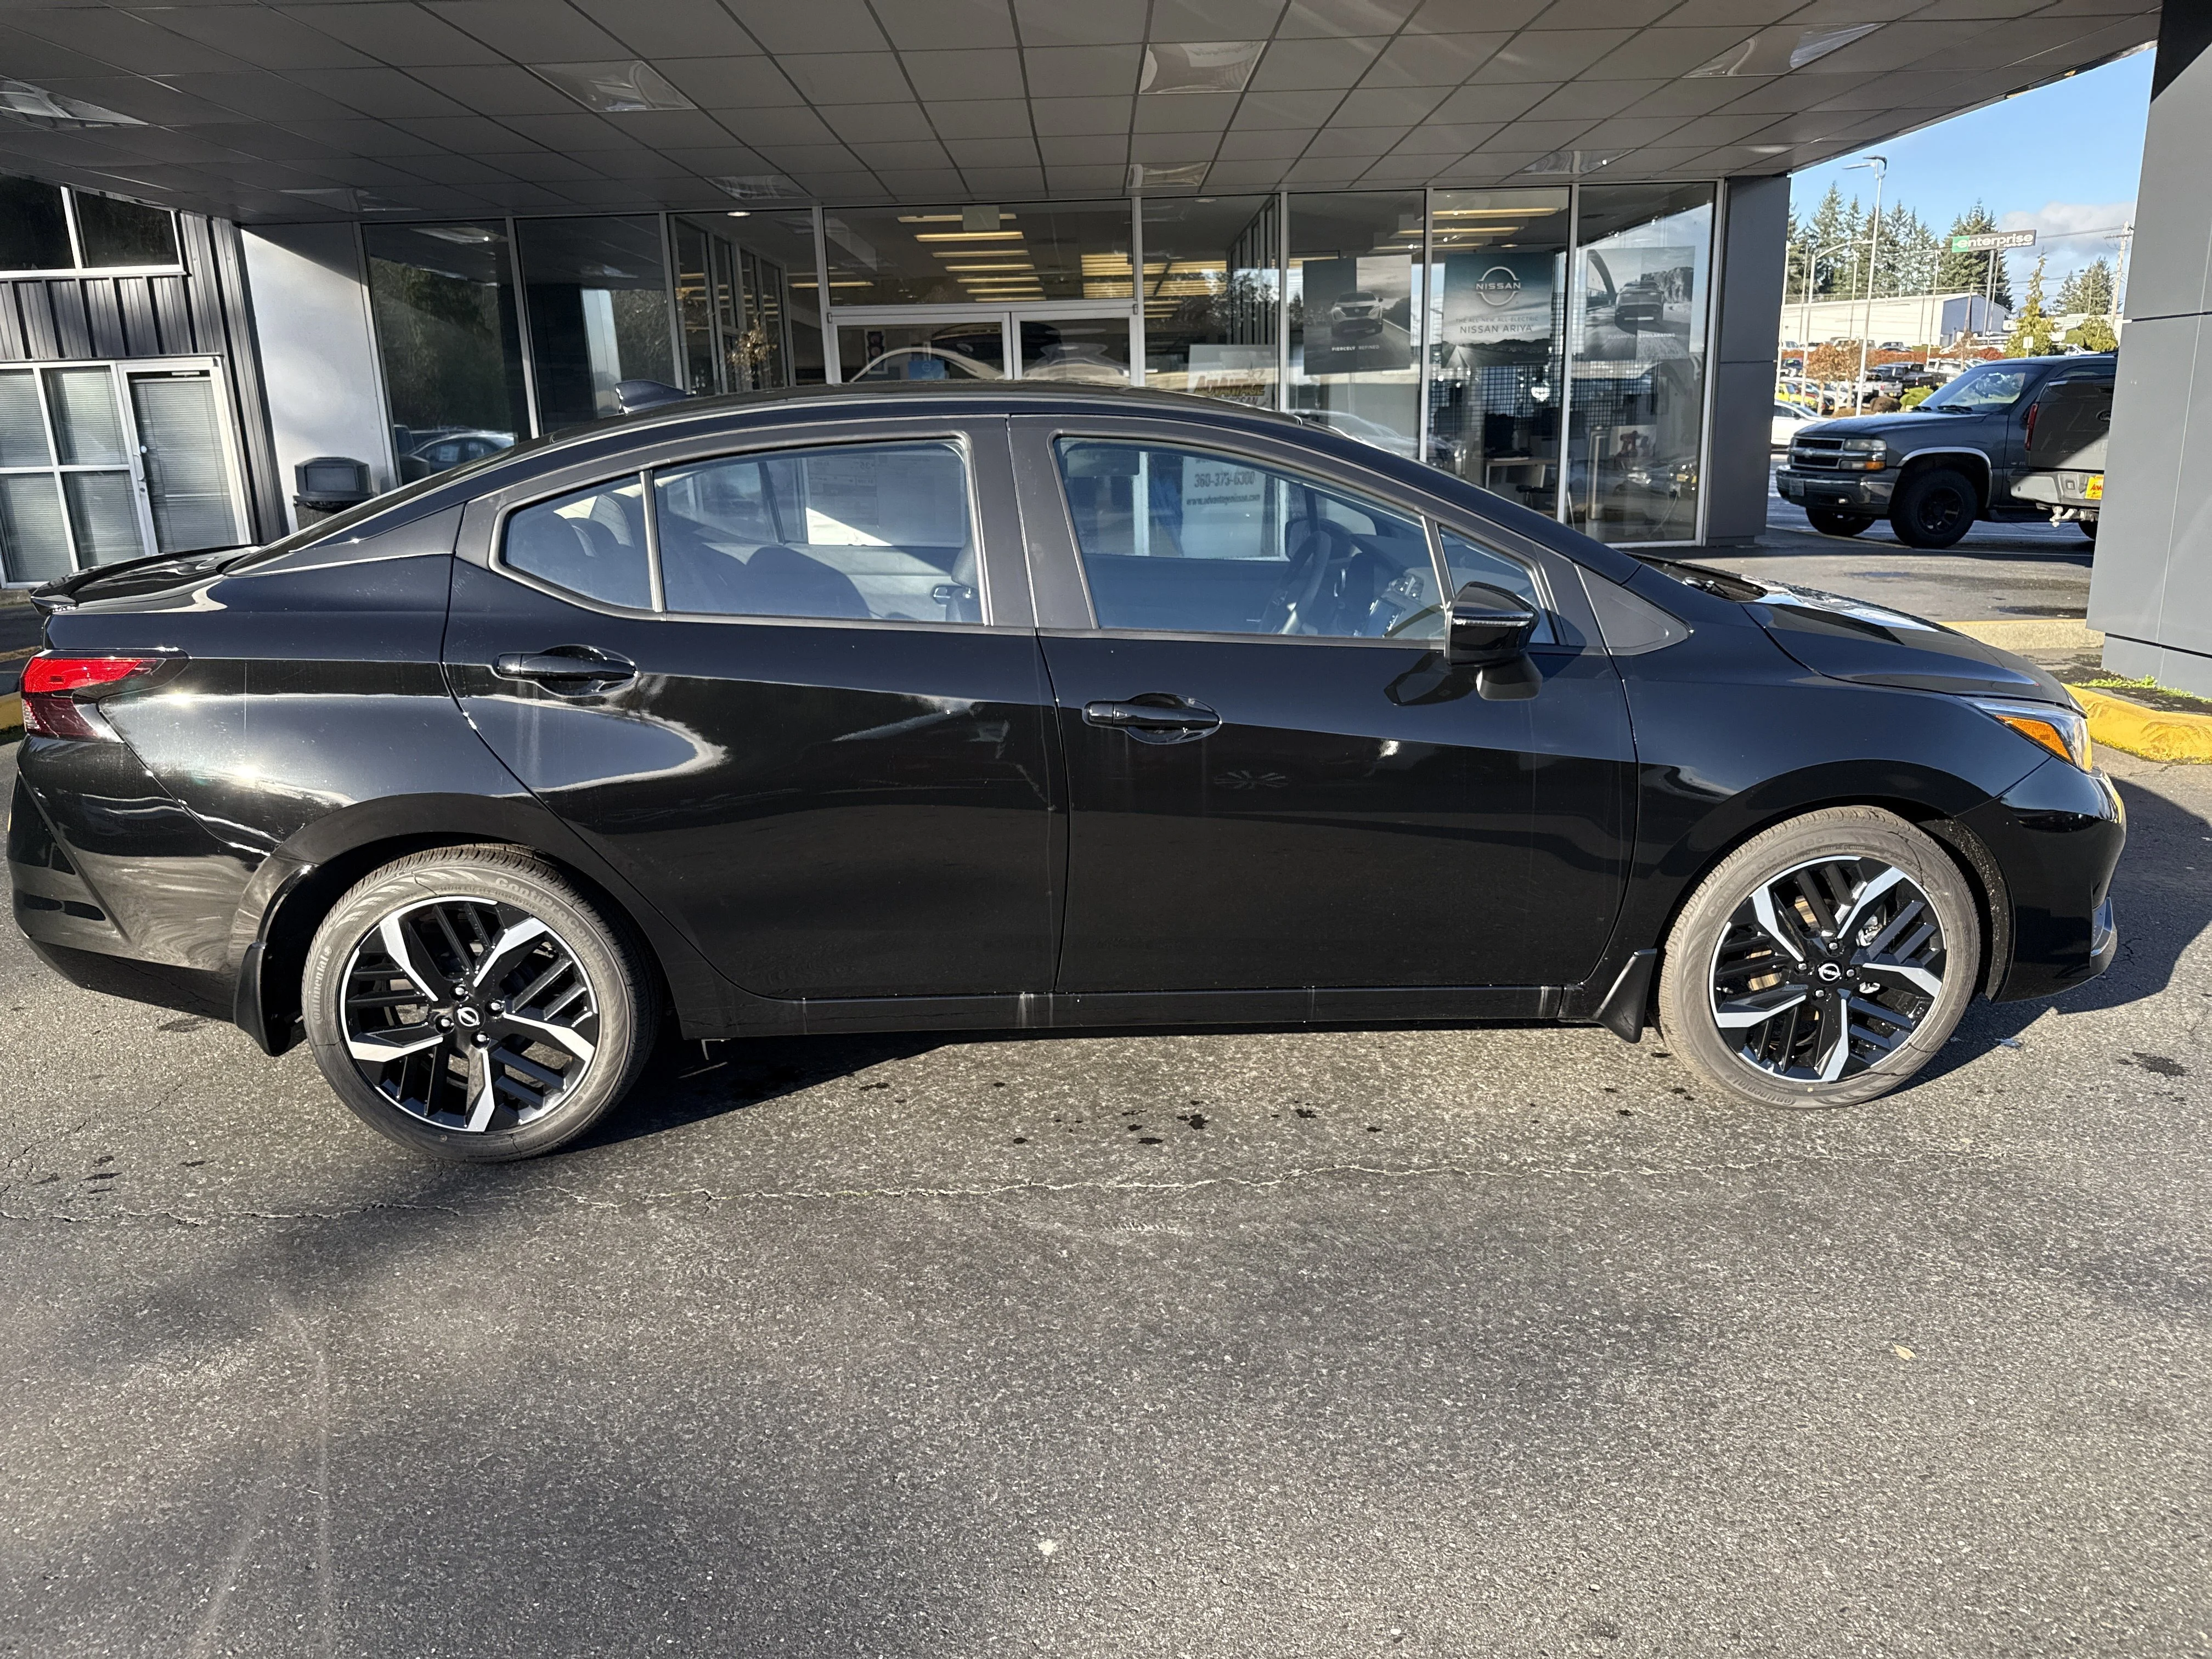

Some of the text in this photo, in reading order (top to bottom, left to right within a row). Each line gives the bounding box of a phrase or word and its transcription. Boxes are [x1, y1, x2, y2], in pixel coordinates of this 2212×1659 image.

[1957, 233, 2033, 248] enterprise
[1460, 324, 1533, 334] NISSAN ARIYA
[1193, 375, 1267, 397] ADVANTAGE
[495, 876, 615, 977] ContiProContact
[311, 955, 330, 1025] Continental
[1737, 1077, 1796, 1106] Continental
